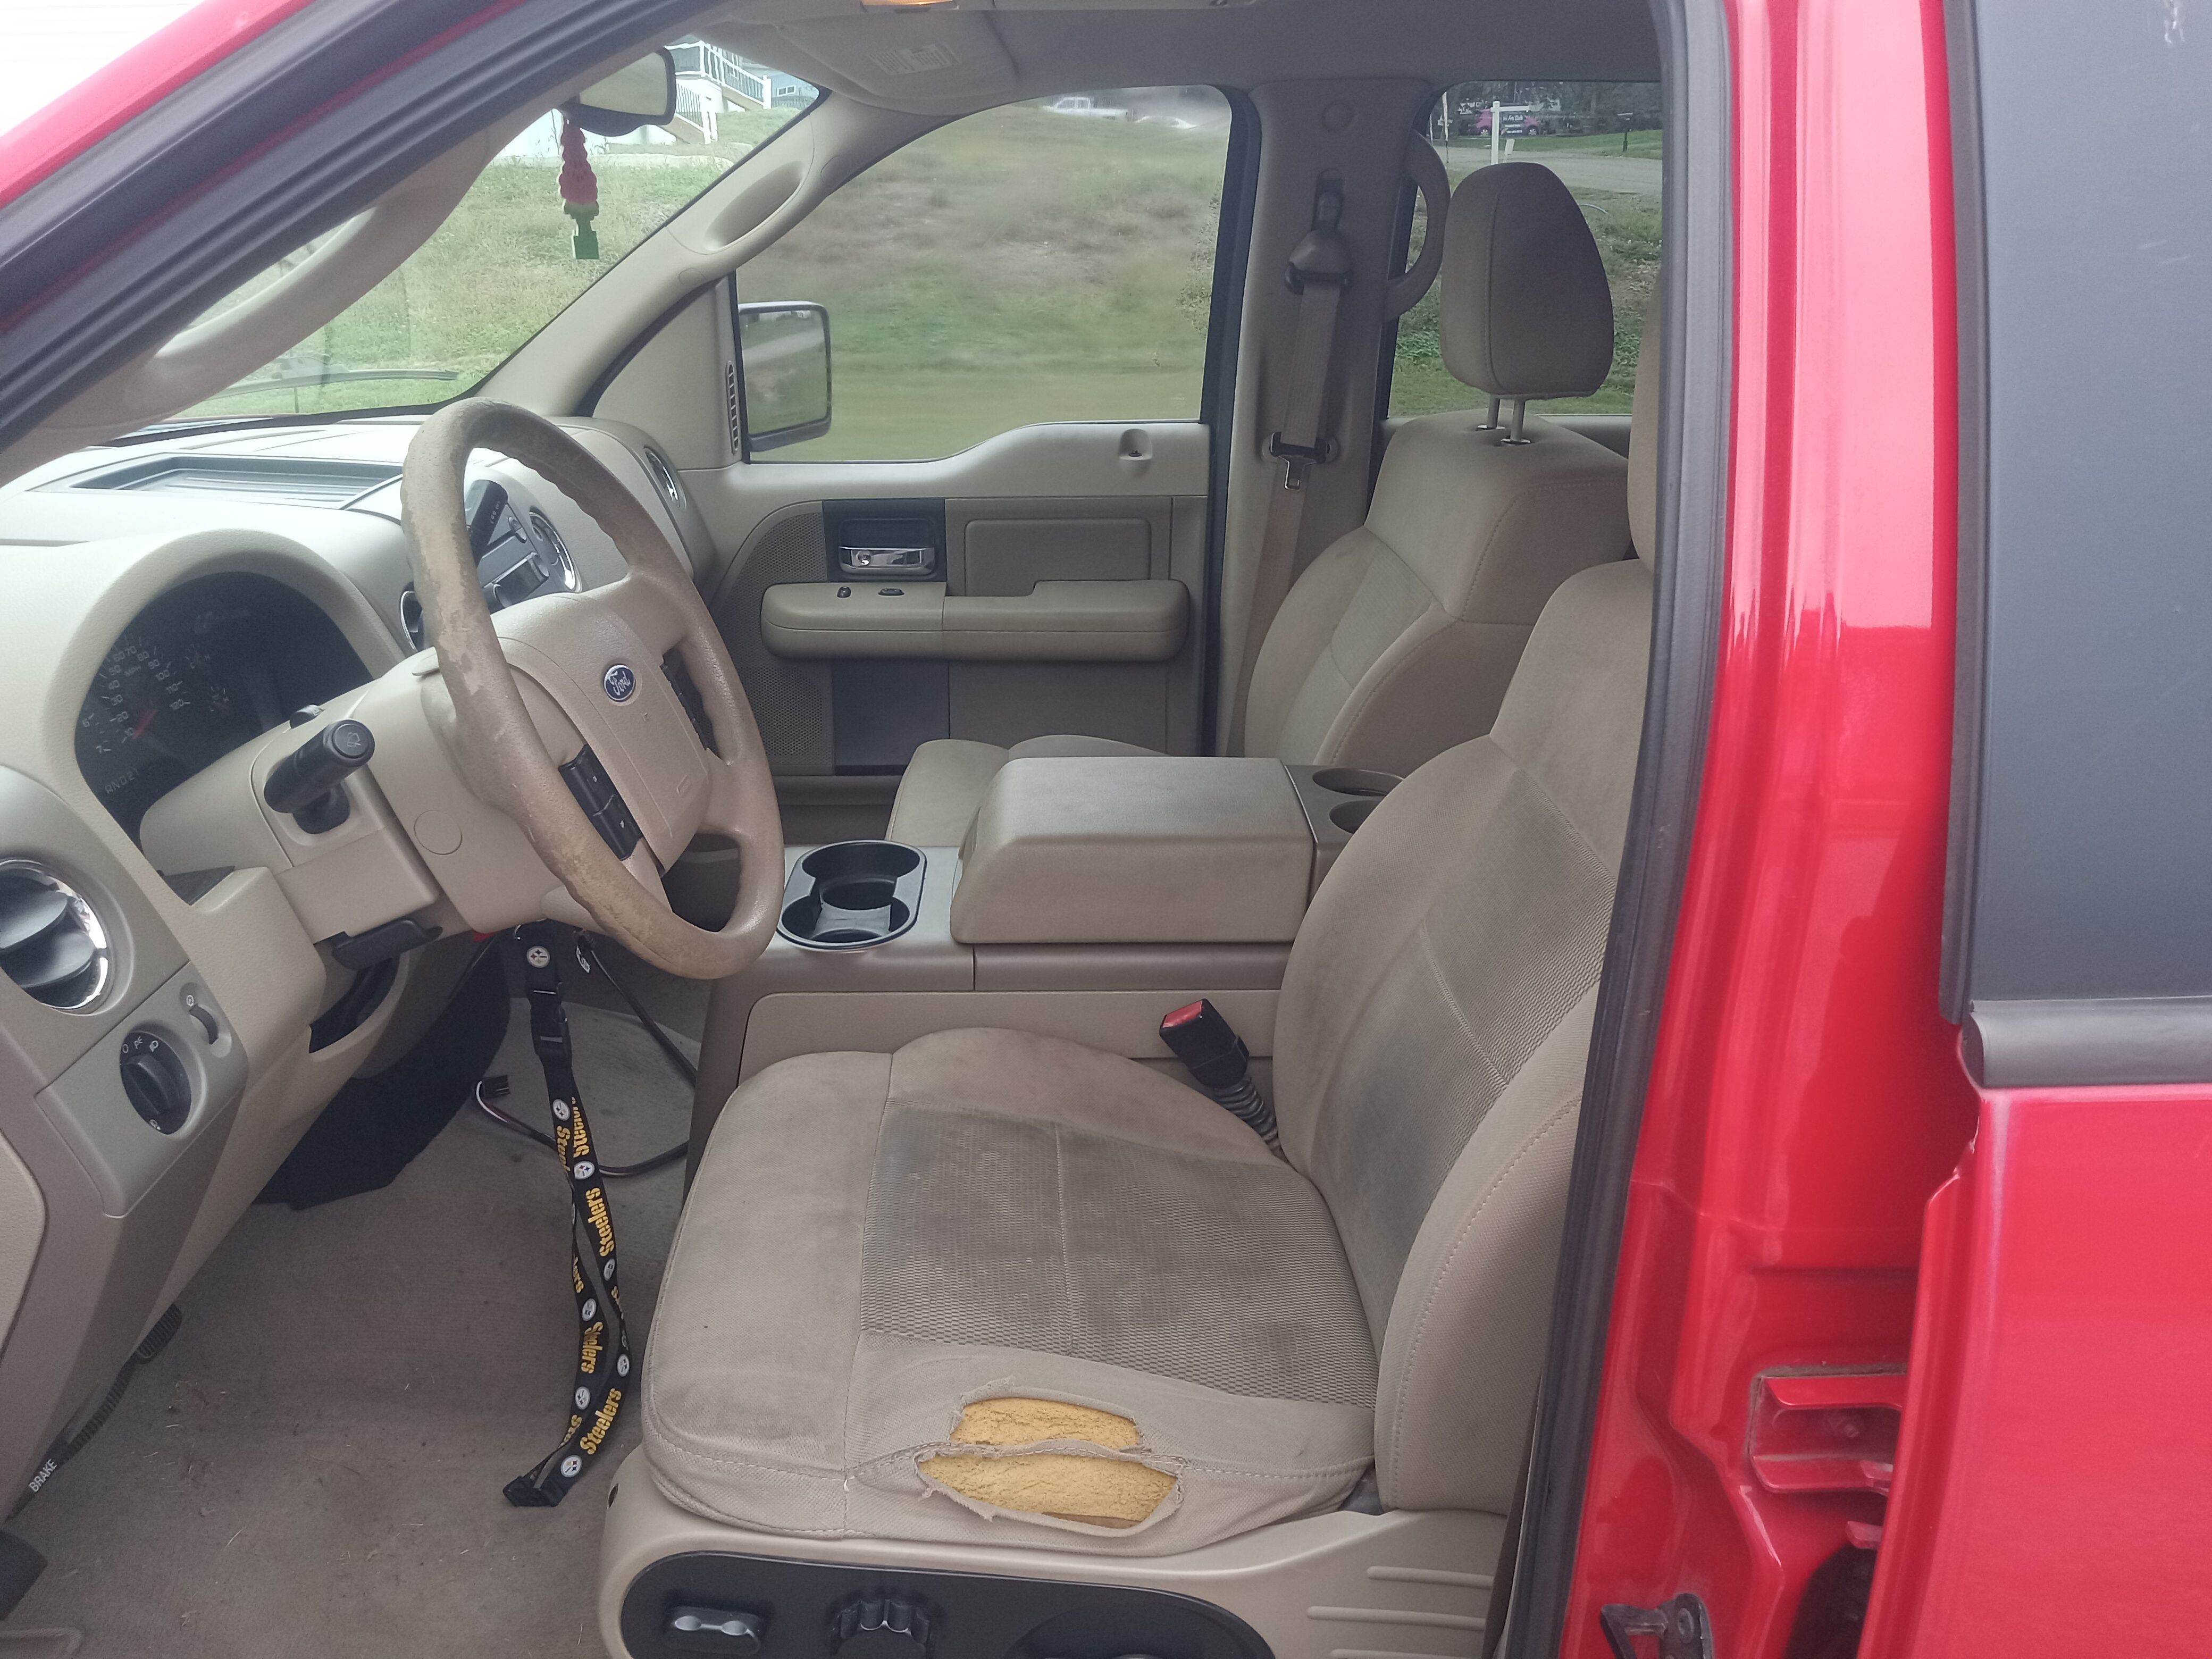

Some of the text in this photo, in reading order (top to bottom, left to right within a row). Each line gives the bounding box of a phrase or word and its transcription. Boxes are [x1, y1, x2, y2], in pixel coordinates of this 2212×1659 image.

[109, 680, 120, 689] 40
[608, 671, 631, 696] Ford
[111, 694, 123, 706] 30
[585, 1187, 615, 1257] Steelers
[580, 1388, 622, 1455] Steelers
[28, 1459, 57, 1493] BRAKE
